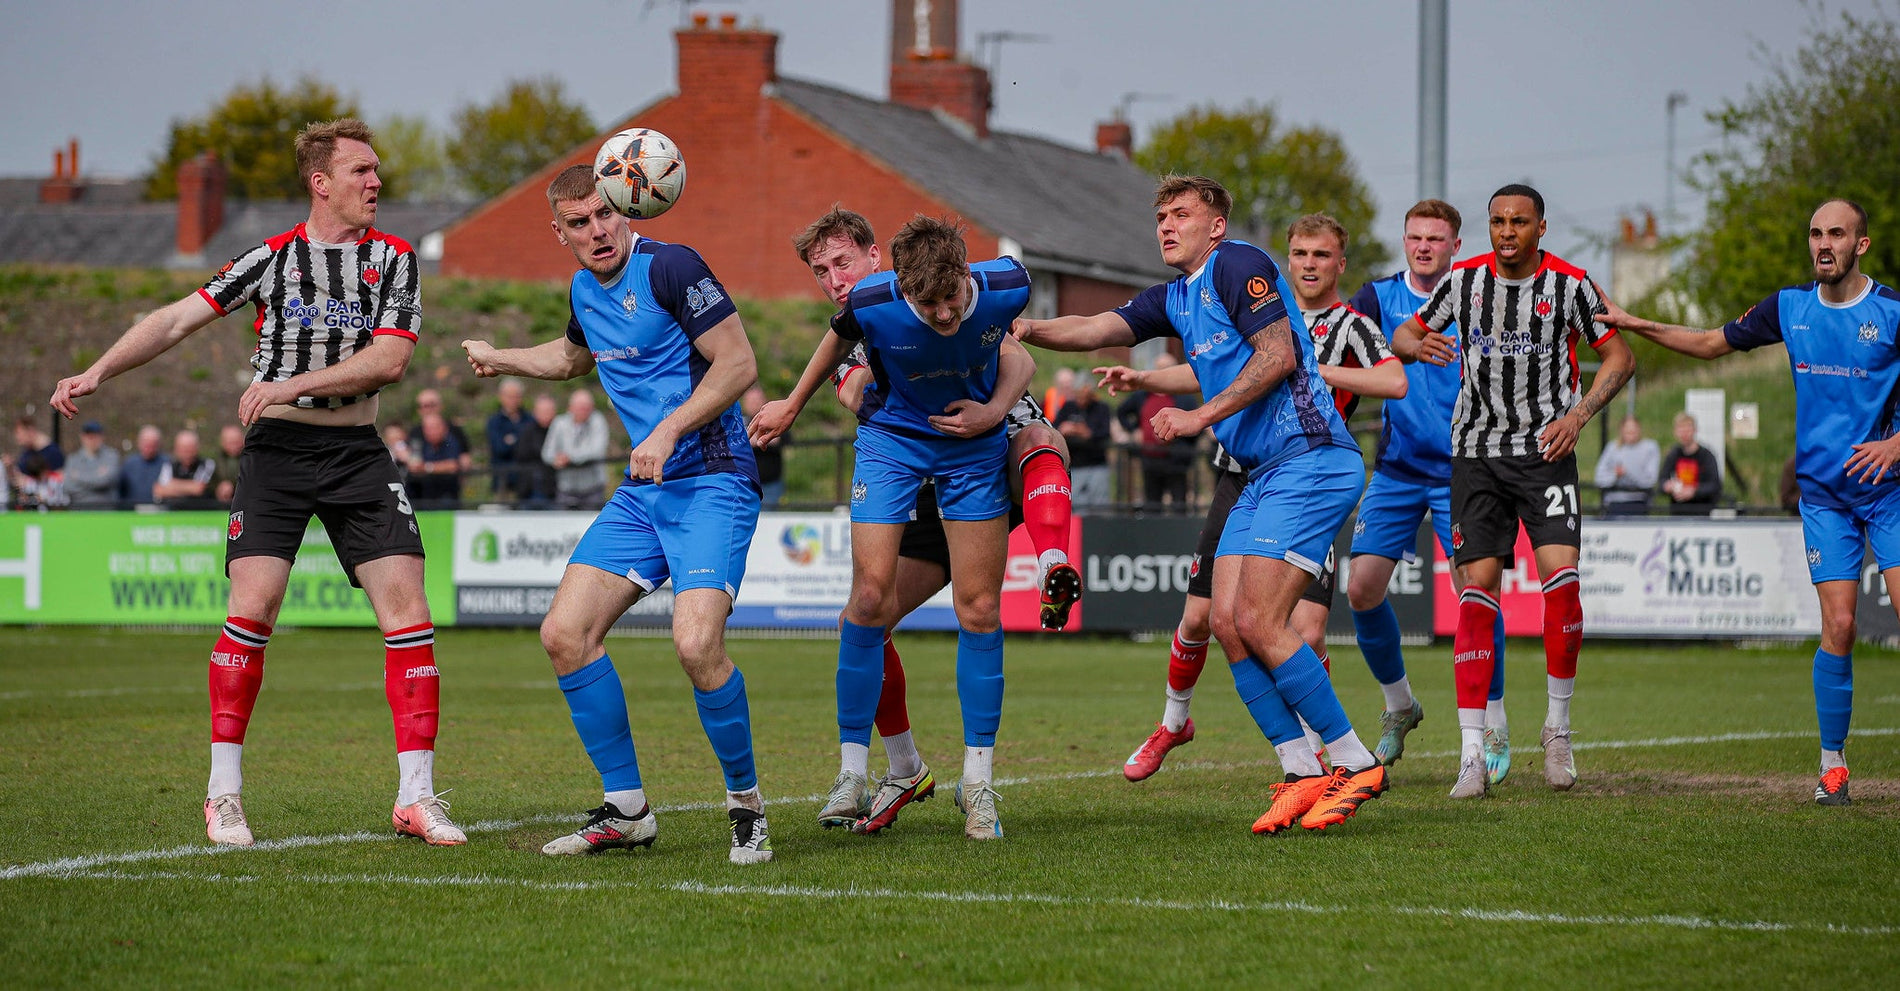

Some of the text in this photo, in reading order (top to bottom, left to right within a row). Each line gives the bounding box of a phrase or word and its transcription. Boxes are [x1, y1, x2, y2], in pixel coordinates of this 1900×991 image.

[285, 307, 316, 319] PAR
[326, 299, 360, 315] PAR
[323, 314, 376, 330] GROU
[1501, 331, 1531, 343] PAR
[1500, 342, 1553, 355] GROUP
[388, 482, 413, 515] 3
[1544, 484, 1578, 517] 21
[1668, 537, 1736, 568] KTB
[1087, 554, 1193, 592] LOSTO
[1668, 567, 1763, 598] Music
[211, 651, 250, 669] CHORLEY
